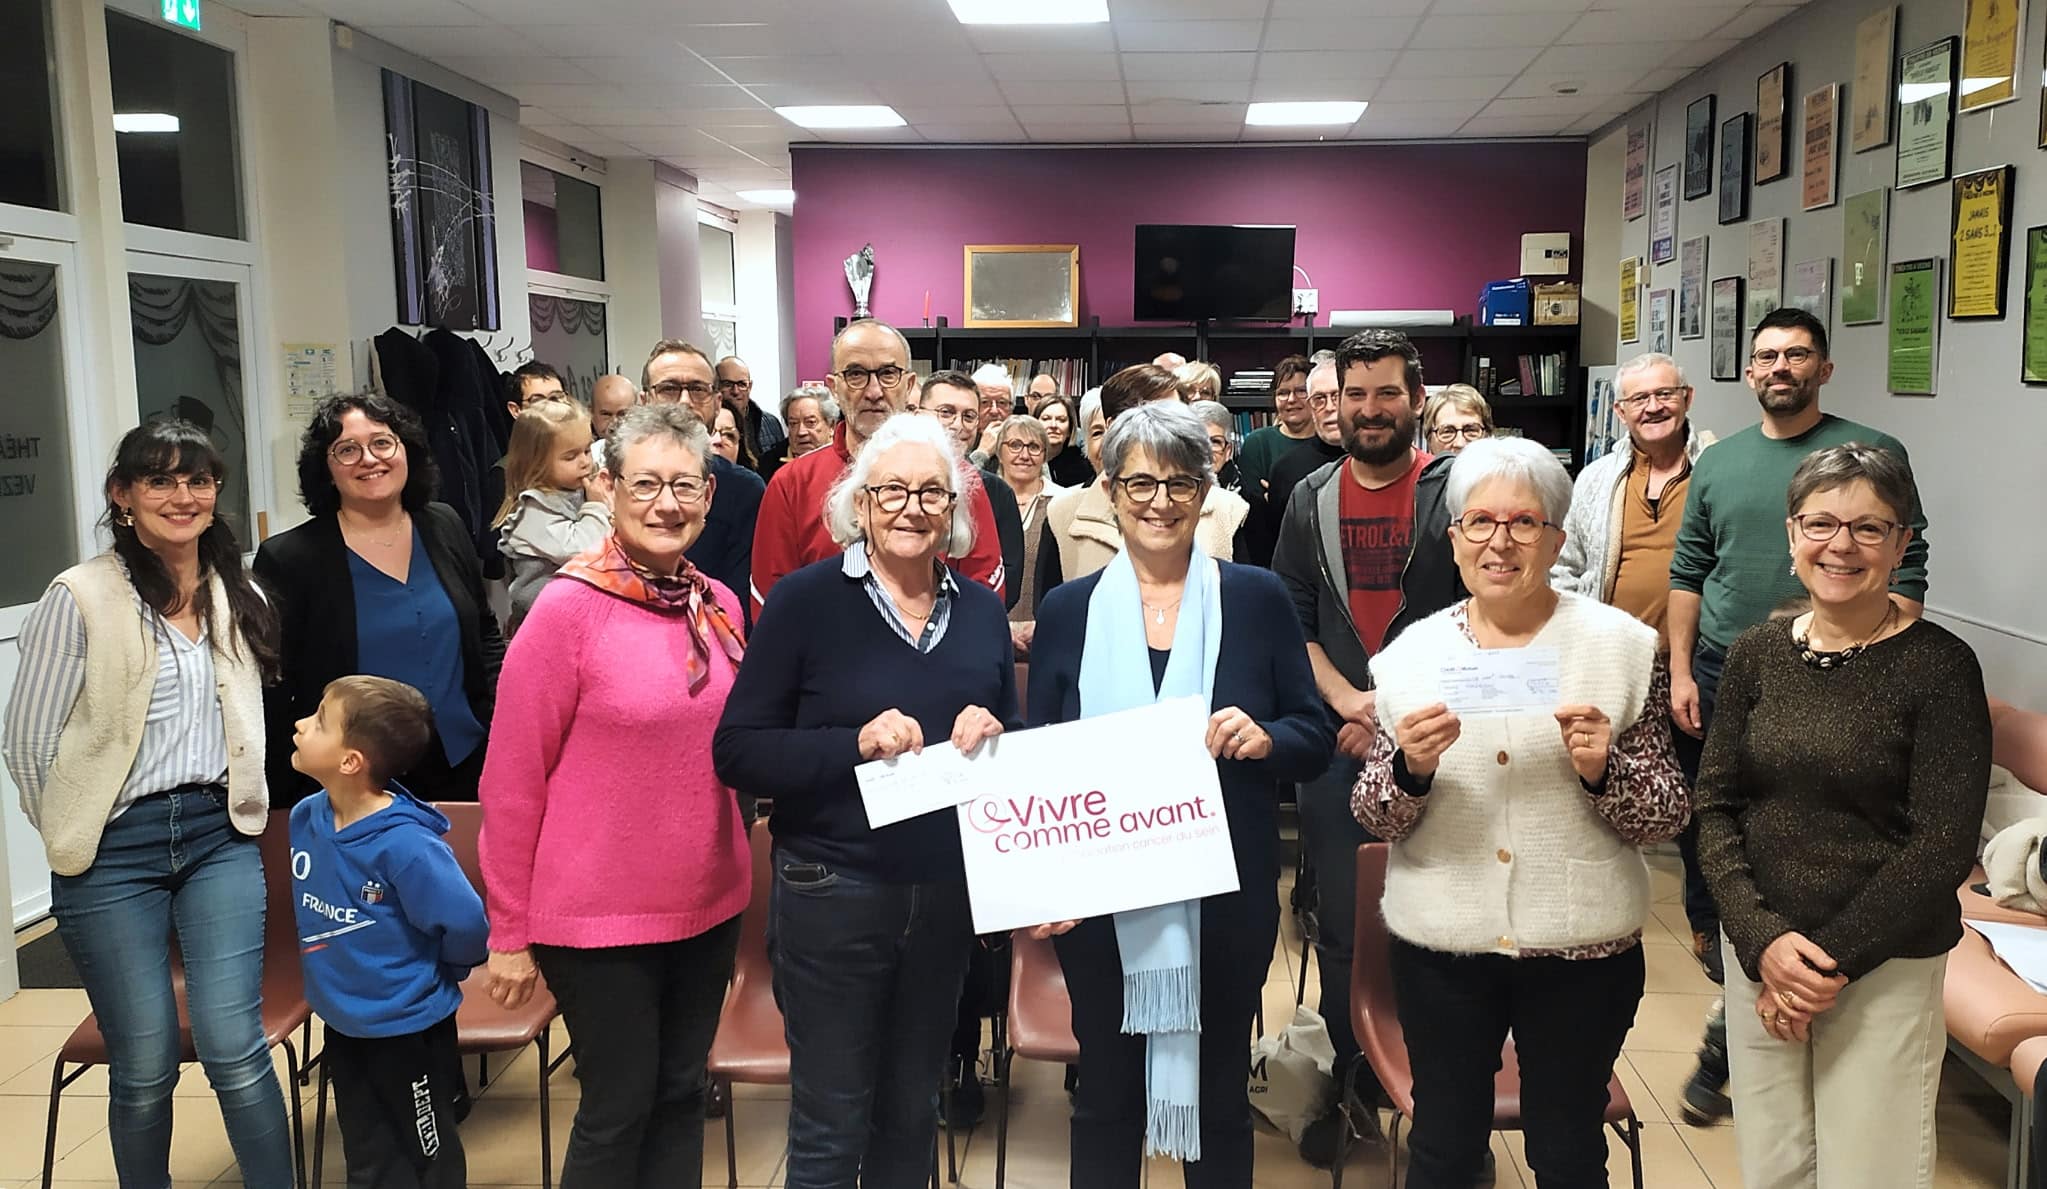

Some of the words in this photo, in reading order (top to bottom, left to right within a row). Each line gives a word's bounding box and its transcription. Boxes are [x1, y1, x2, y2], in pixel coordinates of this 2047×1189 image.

[995, 817, 1111, 853] comme
[1119, 796, 1216, 833] avant.
[1008, 790, 1106, 827] Vivre
[302, 892, 359, 924] FRANCE
[1249, 1085, 1269, 1094] AGRI
